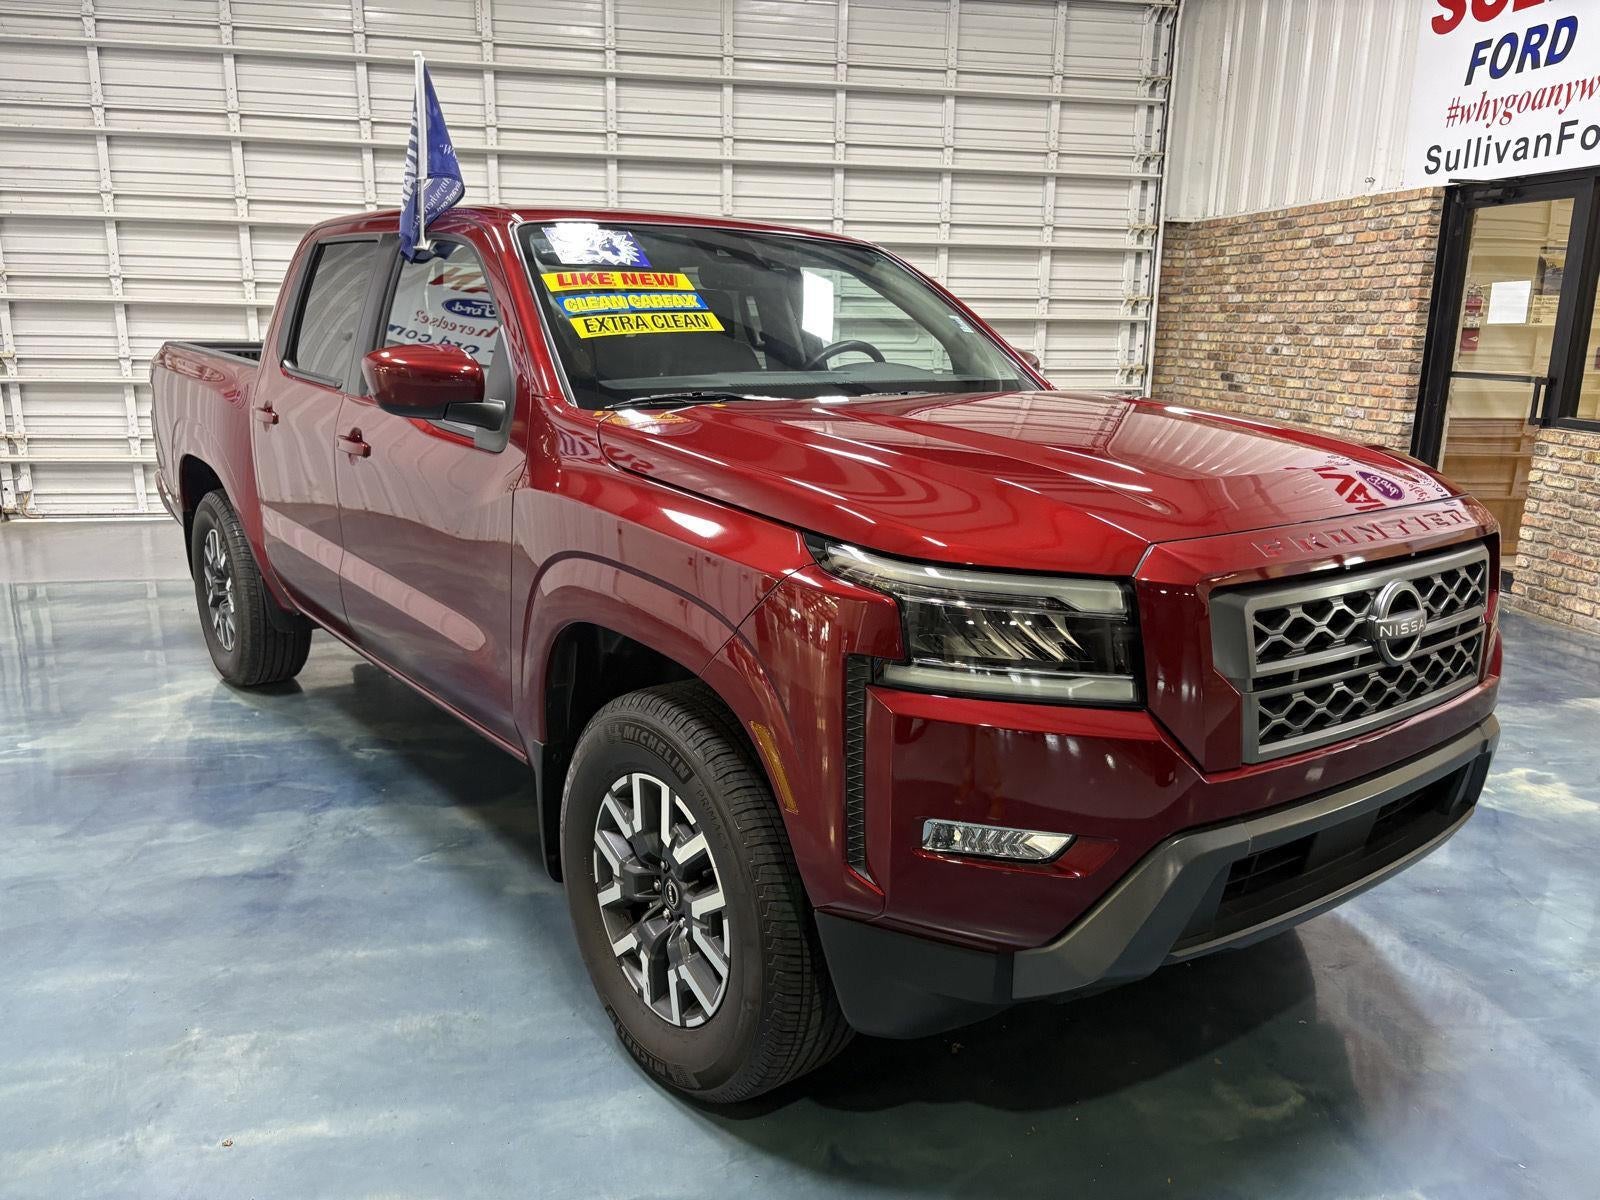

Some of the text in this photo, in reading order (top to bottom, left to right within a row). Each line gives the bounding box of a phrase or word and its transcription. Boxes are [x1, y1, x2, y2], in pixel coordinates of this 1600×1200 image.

[1464, 15, 1579, 87] FORD
[557, 272, 677, 288] LIKE NEW
[563, 294, 701, 312] CLEAN CARFAX
[583, 312, 712, 334] EXTRA CLEAN
[1250, 508, 1471, 559] FRONTIER
[623, 725, 690, 780] MICHELIN
